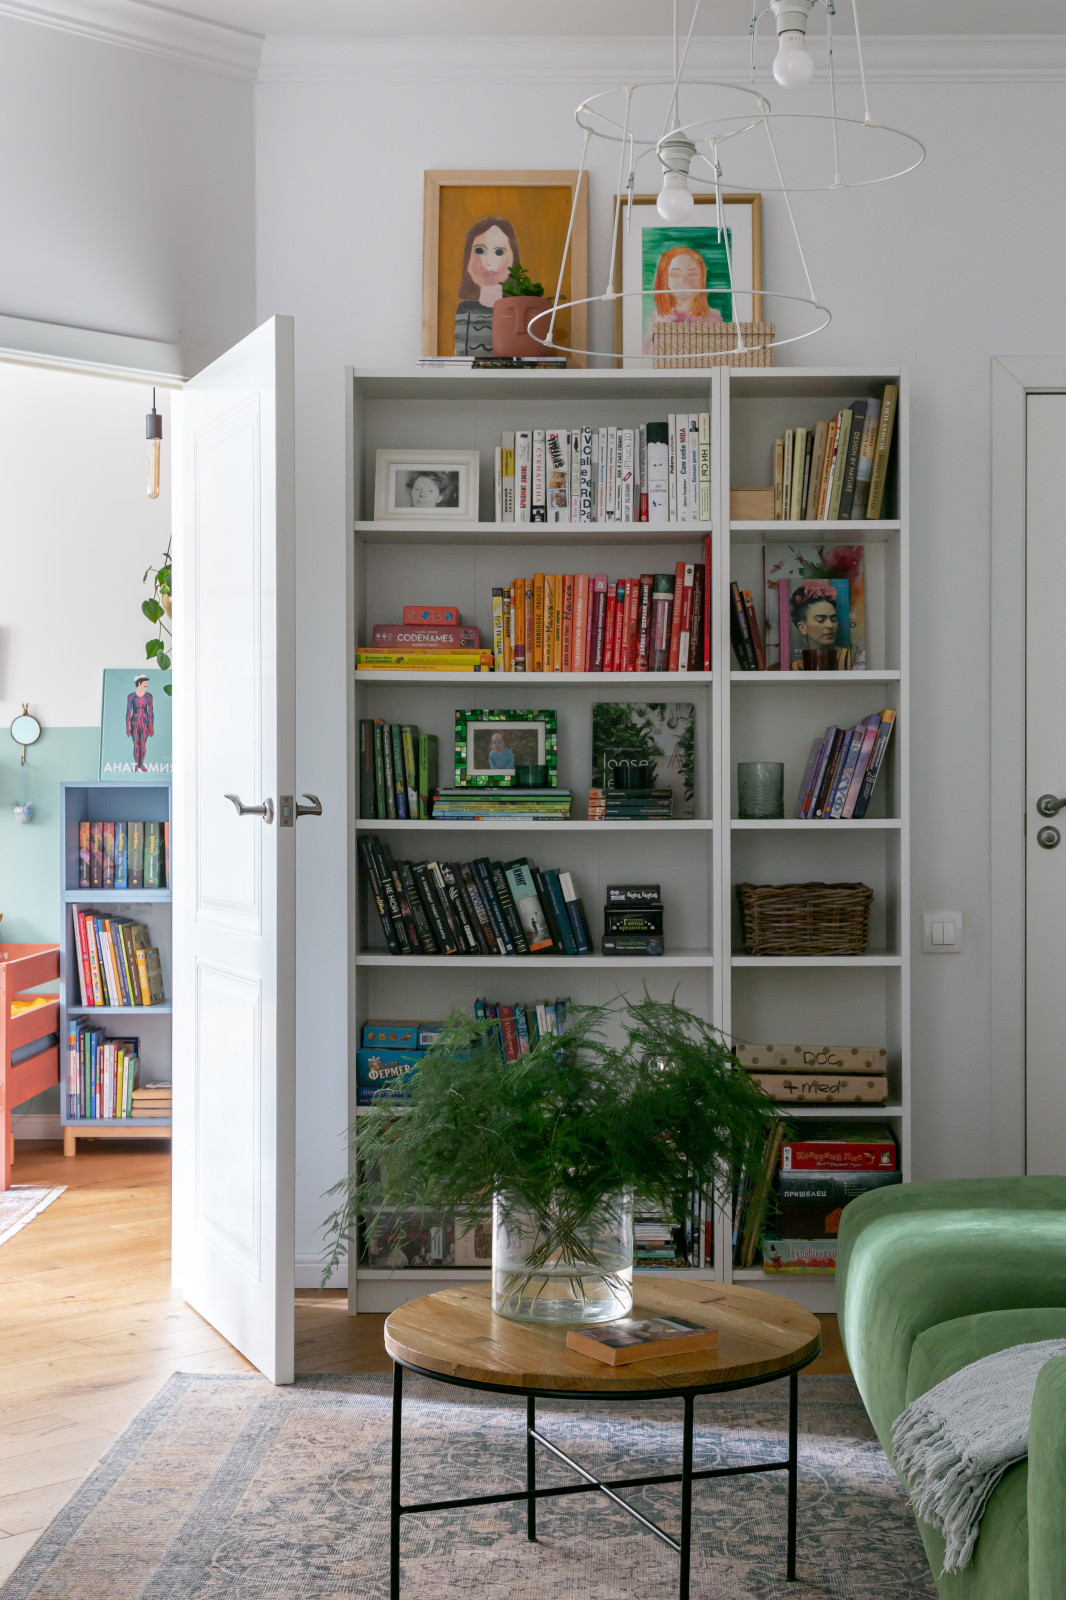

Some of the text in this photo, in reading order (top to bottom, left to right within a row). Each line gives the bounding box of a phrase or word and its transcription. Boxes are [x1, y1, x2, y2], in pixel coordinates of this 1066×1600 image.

[548, 436, 565, 469] SPYFALL
[624, 432, 632, 470] iPhuck 10
[701, 449, 708, 461] НИ
[845, 430, 859, 492] DESIGN BY NATURE
[701, 463, 708, 476] СЫ
[562, 584, 572, 620] Малек
[544, 604, 554, 632] Малек
[397, 633, 454, 643] CODENAMES
[384, 882, 399, 913] НЕ НОЙ
[803, 1052, 838, 1065] DOC
[368, 1064, 411, 1080] ФЕРМЕР
[802, 1080, 840, 1094] med
[796, 1152, 864, 1162] Коварный Лис
